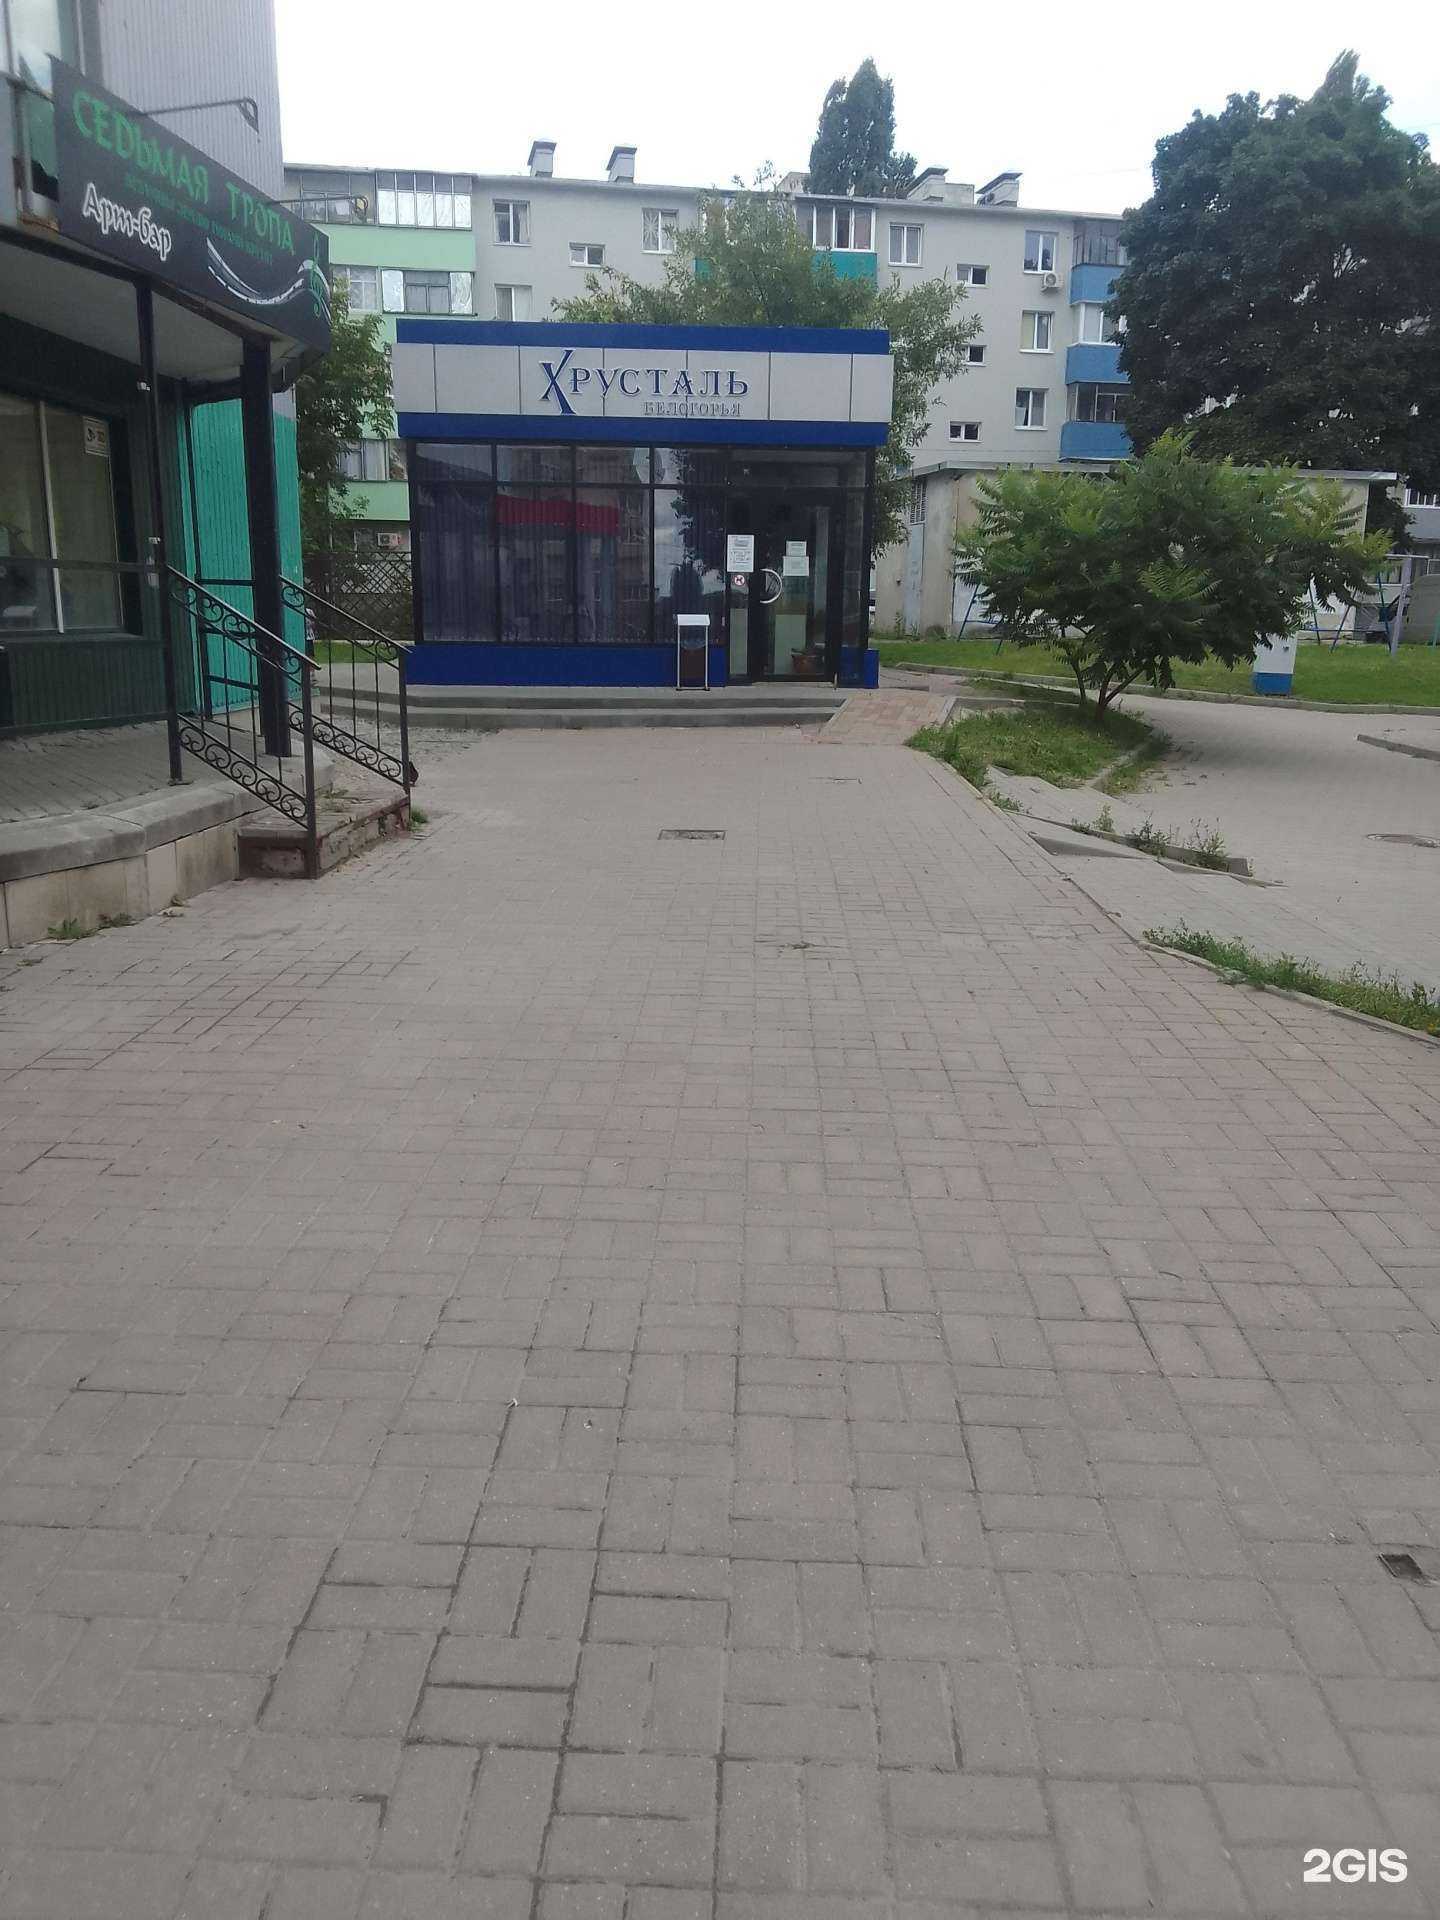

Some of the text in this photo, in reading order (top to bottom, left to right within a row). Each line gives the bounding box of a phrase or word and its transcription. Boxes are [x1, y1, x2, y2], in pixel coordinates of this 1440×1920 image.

[82, 182, 172, 261] Арт-бар
[225, 181, 295, 256] ТРОПА
[539, 348, 749, 416] ХРУСТАЛЬ
[643, 400, 742, 418] БЕЛОГОРЬЯ
